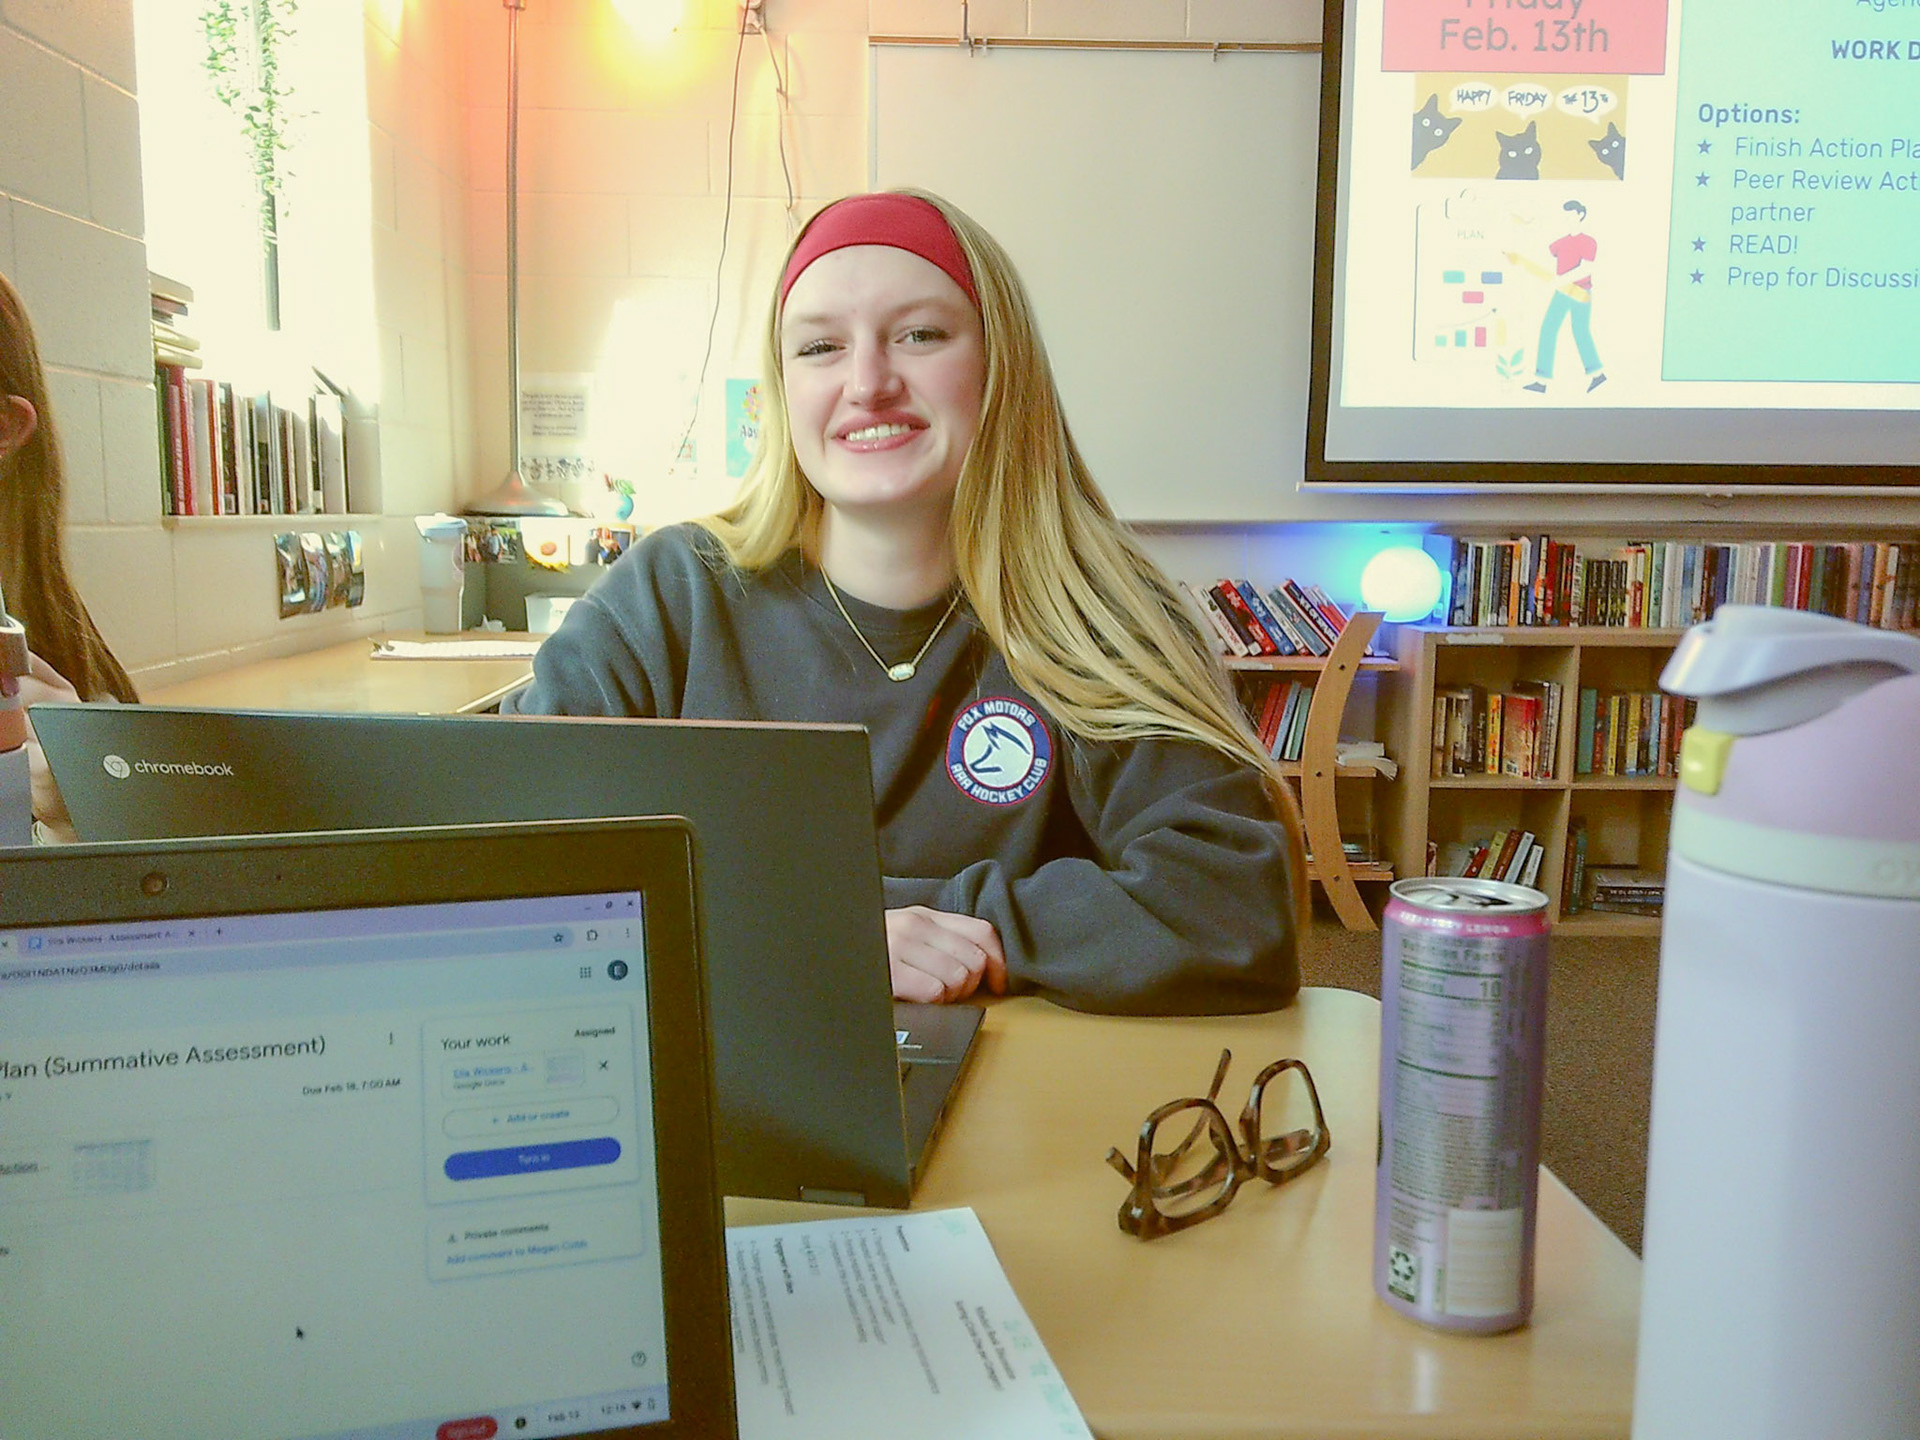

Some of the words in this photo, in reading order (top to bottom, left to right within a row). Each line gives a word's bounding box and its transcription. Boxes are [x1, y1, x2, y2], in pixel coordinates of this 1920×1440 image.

[1440, 18, 1517, 51] Feb.
[1533, 18, 1608, 52] 13th
[1831, 39, 1901, 60] WORK
[1456, 89, 1491, 106] HAPPY
[1507, 90, 1548, 107] FRIDAY
[1698, 103, 1800, 128] Options:
[1735, 136, 1802, 157] Finish
[1809, 138, 1883, 158] Action
[1733, 169, 1785, 189] Peer
[1792, 170, 1873, 190] Review
[1731, 202, 1816, 225] partner
[1729, 234, 1799, 255] READ!
[1727, 266, 1780, 291] Prep
[1786, 266, 1819, 288] for
[957, 705, 983, 731] FOX
[983, 700, 1037, 728] MOTORS
[134, 759, 235, 777] chromebook
[970, 784, 1025, 803] HOCKEY
[1023, 757, 1048, 792] CLUB
[441, 1037, 471, 1051] Your
[476, 1034, 511, 1047] work
[574, 1026, 616, 1038] Assigned
[0, 1061, 37, 1080] lan
[45, 1047, 179, 1077] (Summative
[185, 1035, 326, 1064] Assessment)
